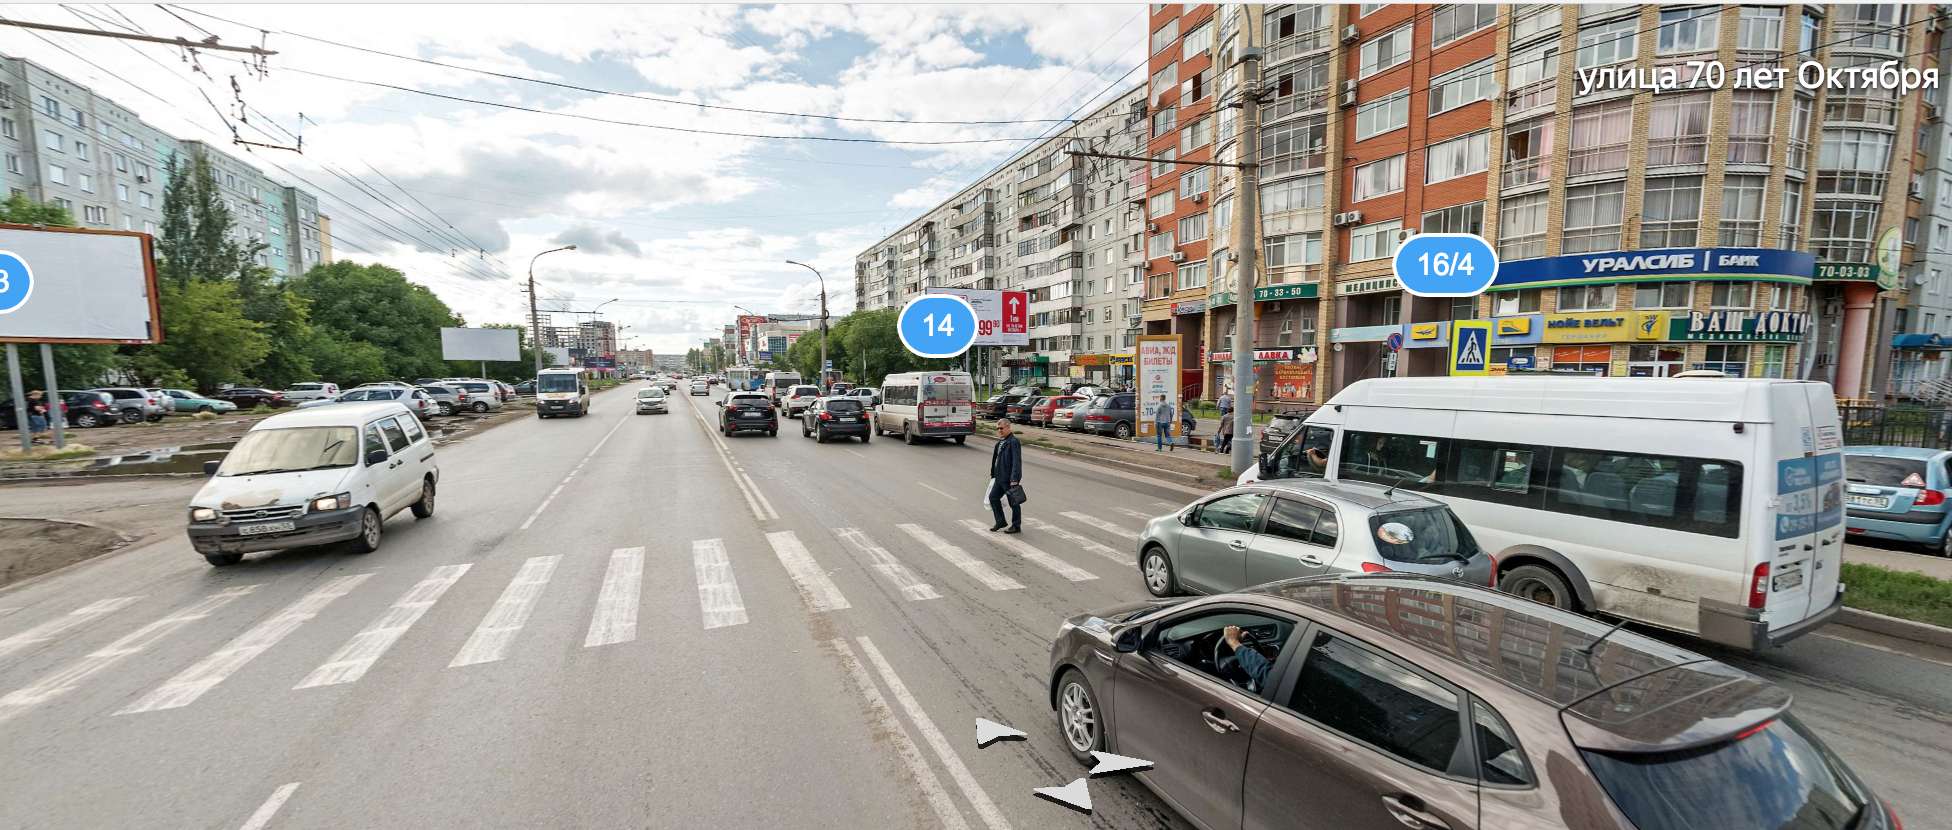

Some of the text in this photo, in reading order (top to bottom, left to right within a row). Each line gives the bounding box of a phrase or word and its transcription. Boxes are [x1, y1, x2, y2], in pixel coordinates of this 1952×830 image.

[1582, 253, 1760, 273] УРАЛСИБ БАНК
[1819, 265, 1870, 278] 70-03-03
[1345, 278, 1401, 293] МЕДИЦИНС
[1548, 317, 1624, 328] НОЙЕ ВЕЛЬТ
[1689, 311, 1744, 332] ВАШ
[1141, 346, 1162, 356] АВИА,
[1258, 351, 1289, 360] ЛАВКА
[1143, 357, 1173, 366] БИЛЕТЫ
